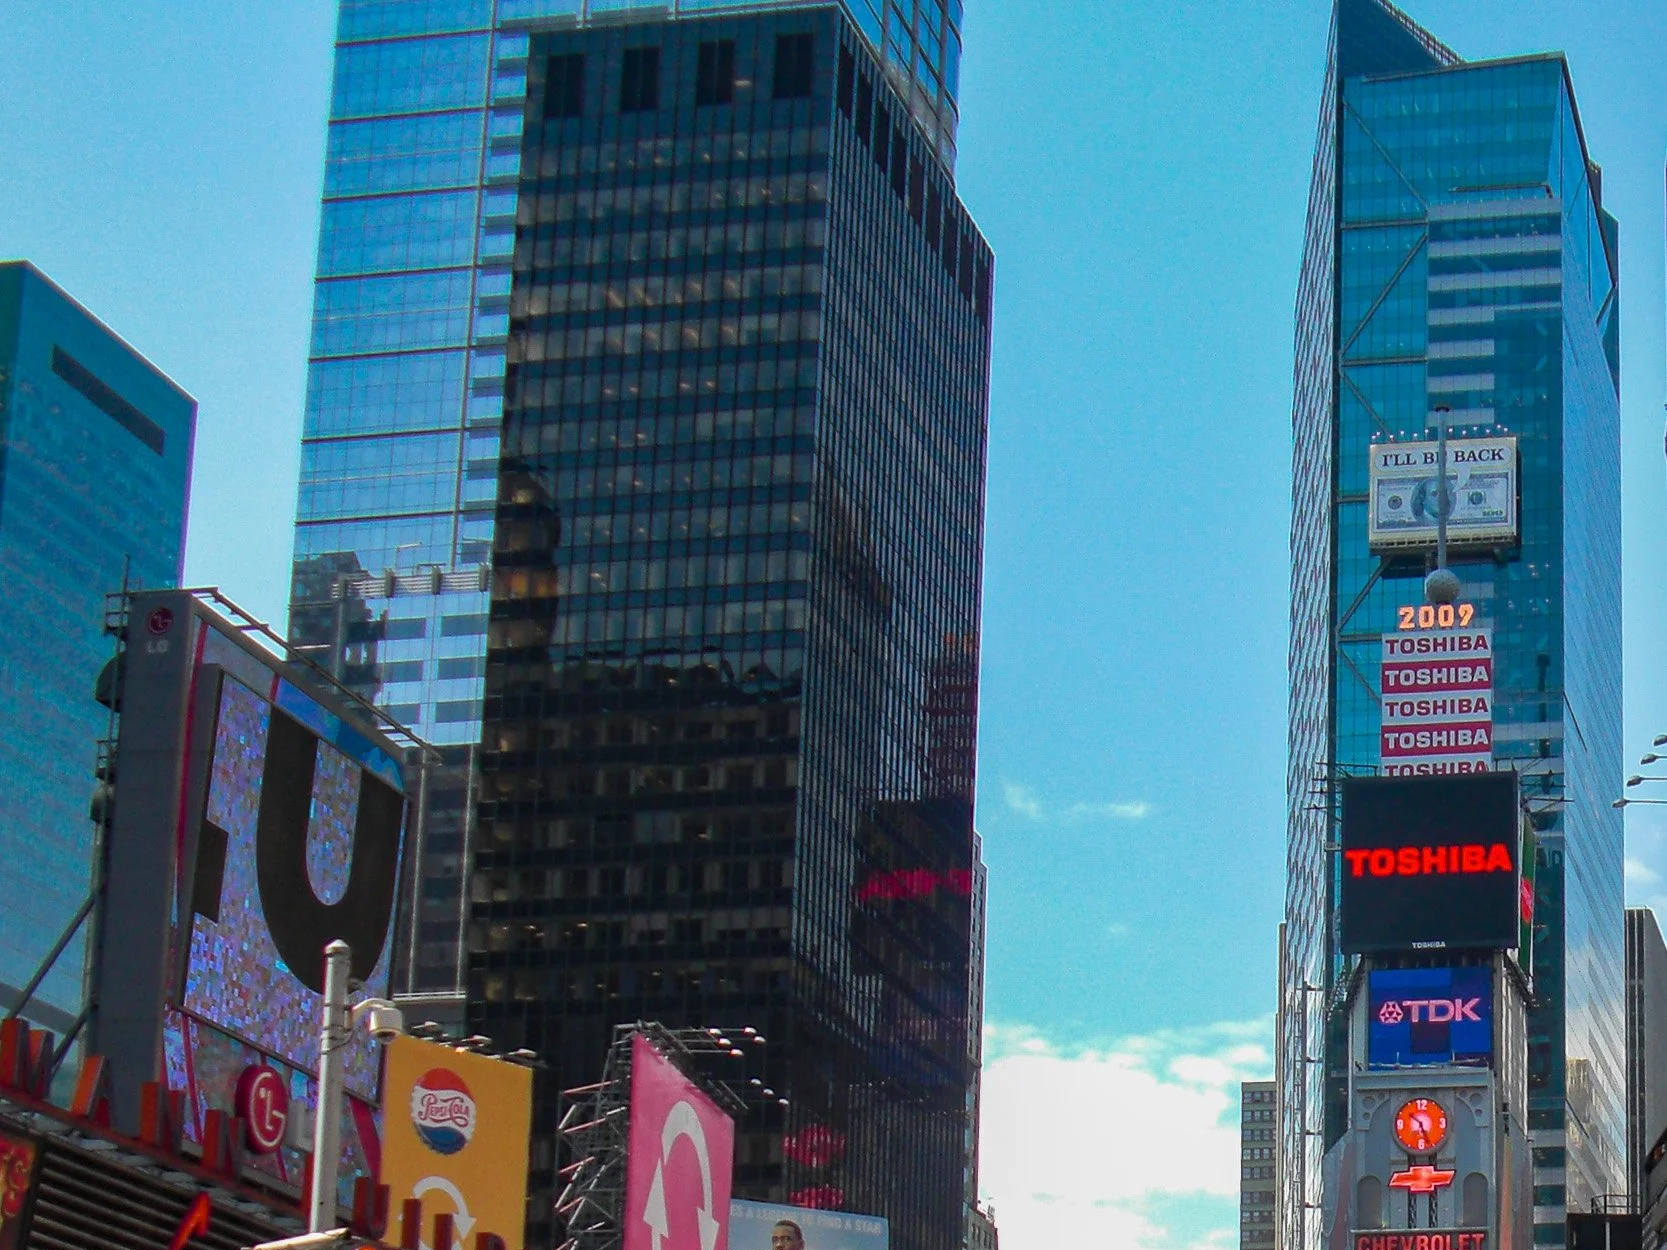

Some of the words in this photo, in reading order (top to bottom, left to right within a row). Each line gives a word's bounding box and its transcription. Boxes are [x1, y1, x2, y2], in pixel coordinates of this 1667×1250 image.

[1382, 452, 1417, 467] I'LL
[1454, 448, 1505, 463] BACK
[1399, 604, 1475, 629] 2009
[1385, 635, 1489, 654] TOSHIBA
[1385, 665, 1489, 686] TOSHIBA
[1385, 697, 1489, 717] TOSHIBA
[1384, 729, 1489, 749] TOSHIBA
[1384, 761, 1489, 777] TOSHIBA
[1345, 844, 1513, 877] TOSHIBA
[1412, 940, 1446, 949] TOSHIBA
[1403, 997, 1481, 1022] TDK
[1416, 1100, 1428, 1111] 12
